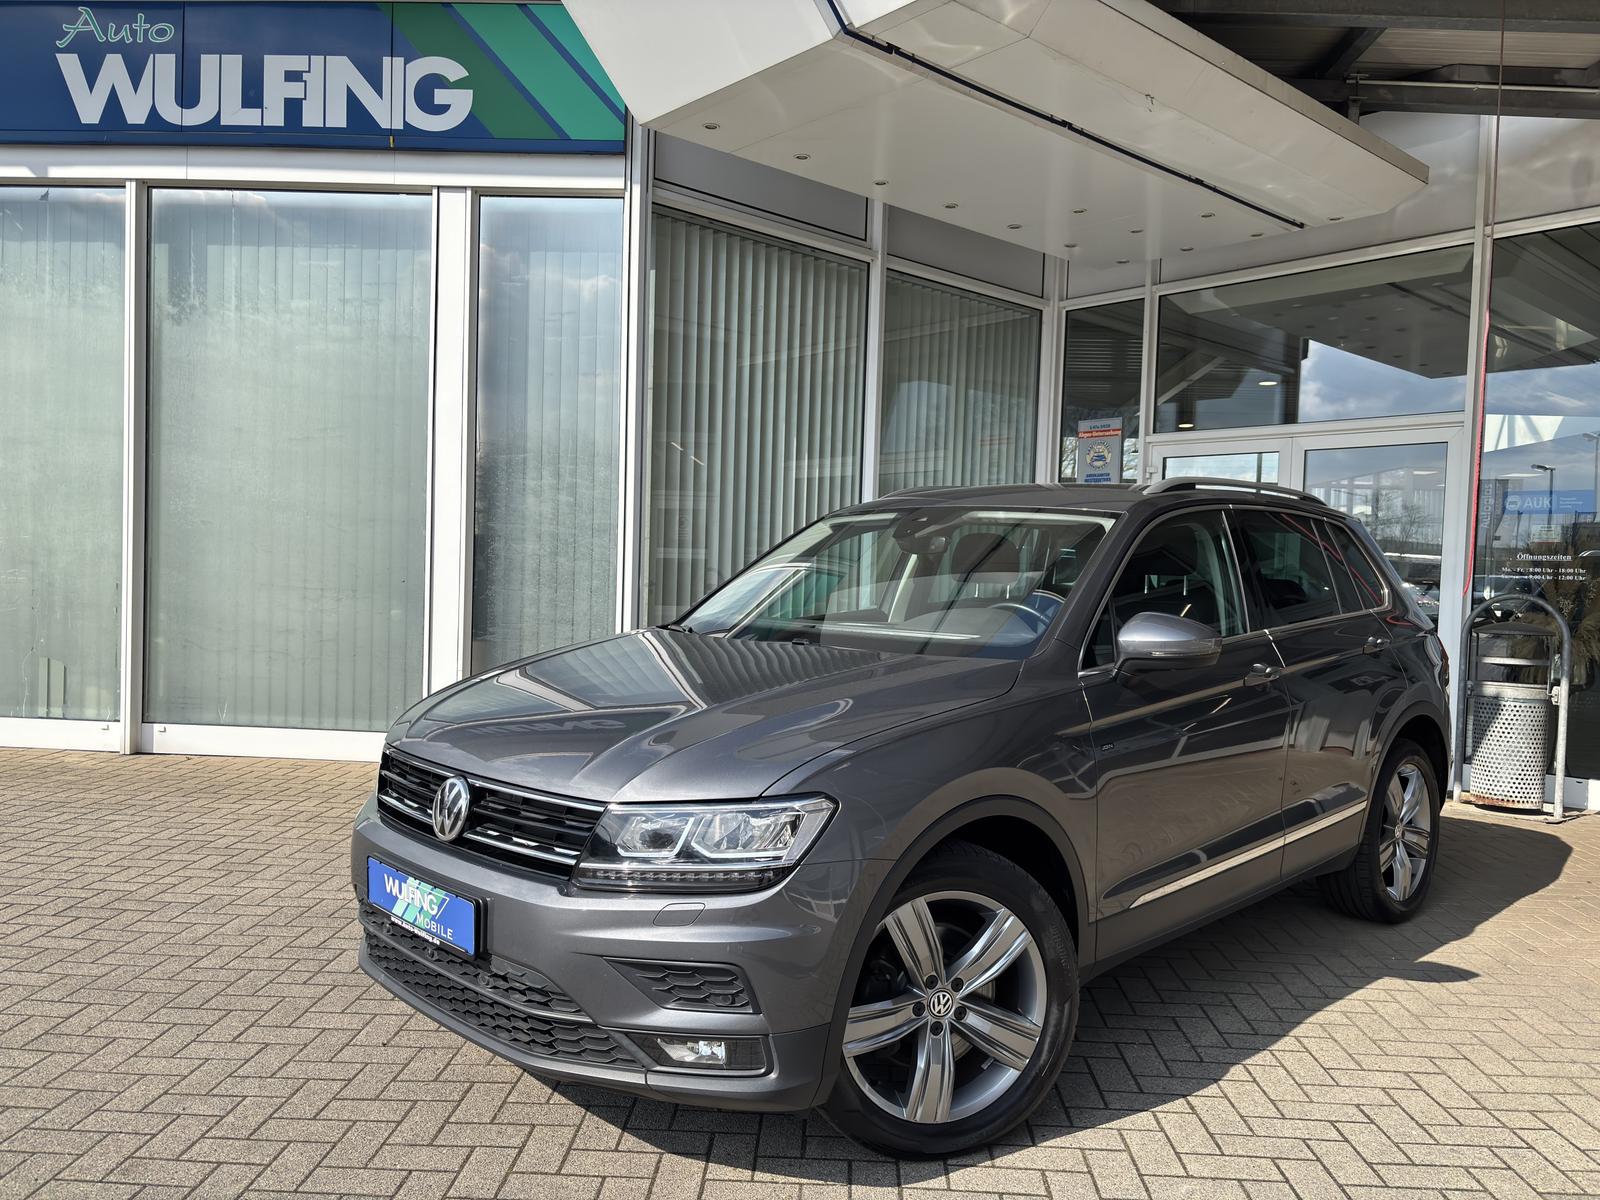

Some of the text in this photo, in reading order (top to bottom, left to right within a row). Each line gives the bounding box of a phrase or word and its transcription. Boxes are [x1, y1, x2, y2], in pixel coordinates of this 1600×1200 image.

[55, 6, 175, 48] Auto
[55, 52, 474, 132] WULFING
[1516, 552, 1572, 561] Öffnungszeiten
[383, 873, 438, 915] WULFING
